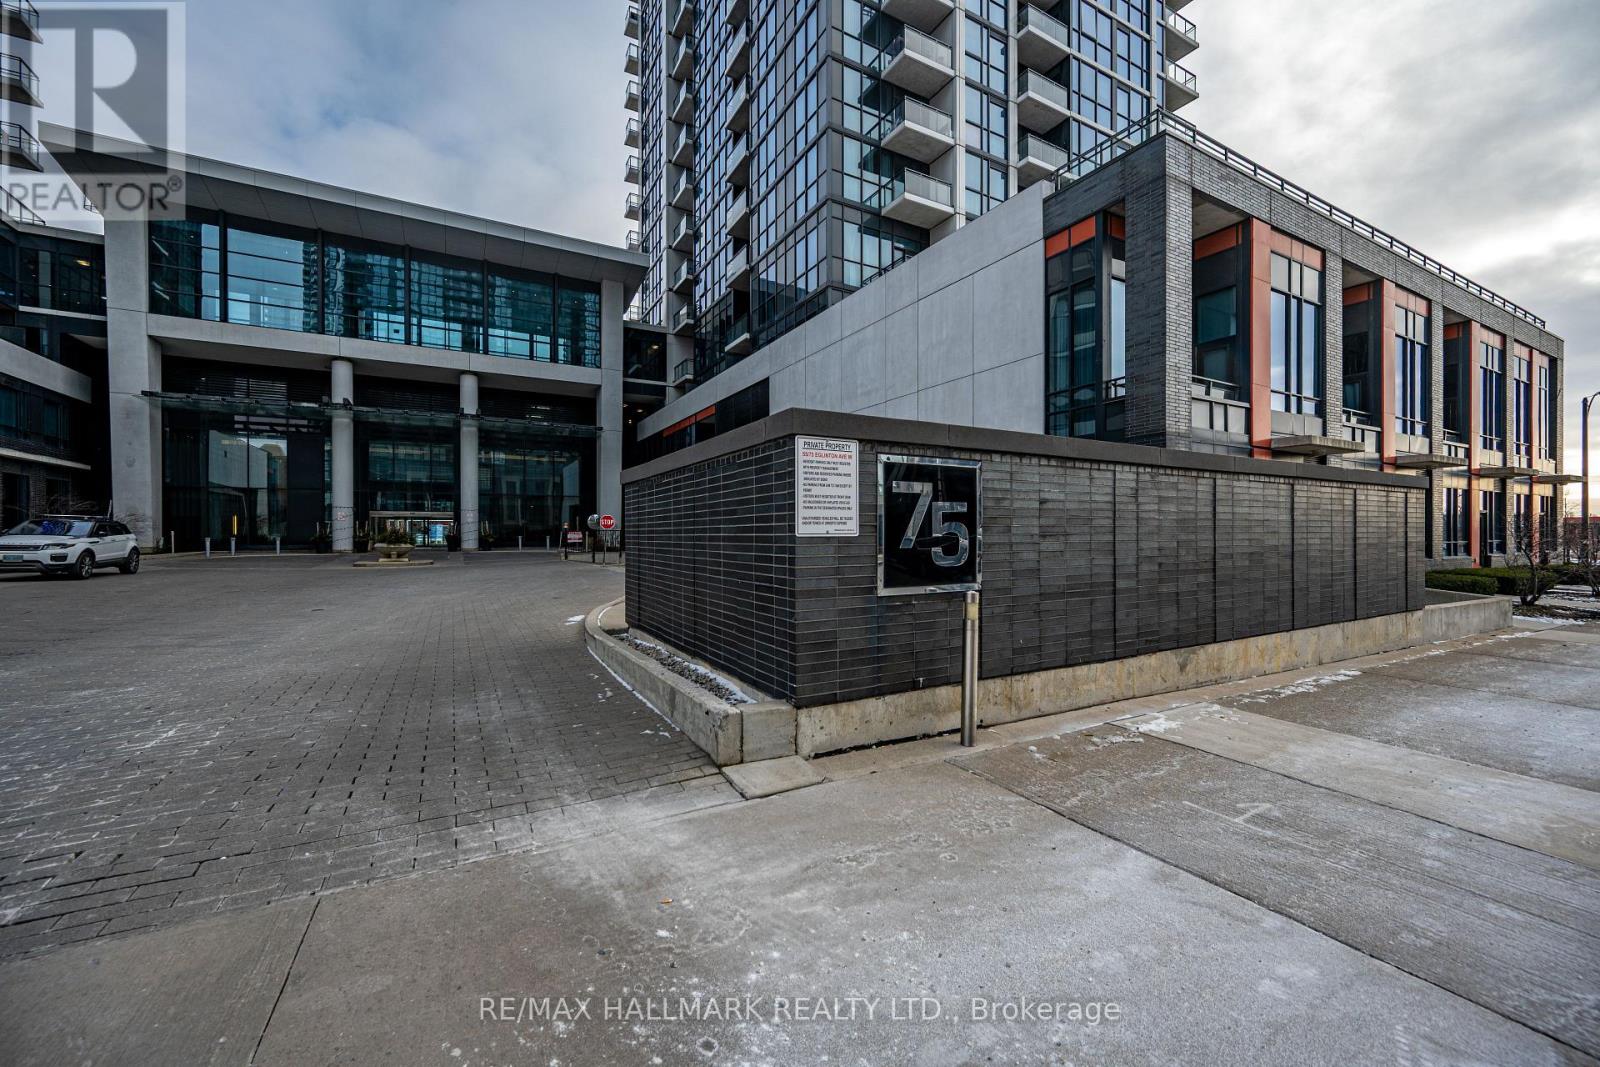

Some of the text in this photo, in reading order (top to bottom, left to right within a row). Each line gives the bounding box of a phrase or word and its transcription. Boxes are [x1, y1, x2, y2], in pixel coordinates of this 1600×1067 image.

[803, 441, 852, 451] PRIVATE PROPERTY
[892, 480, 969, 567] 75
